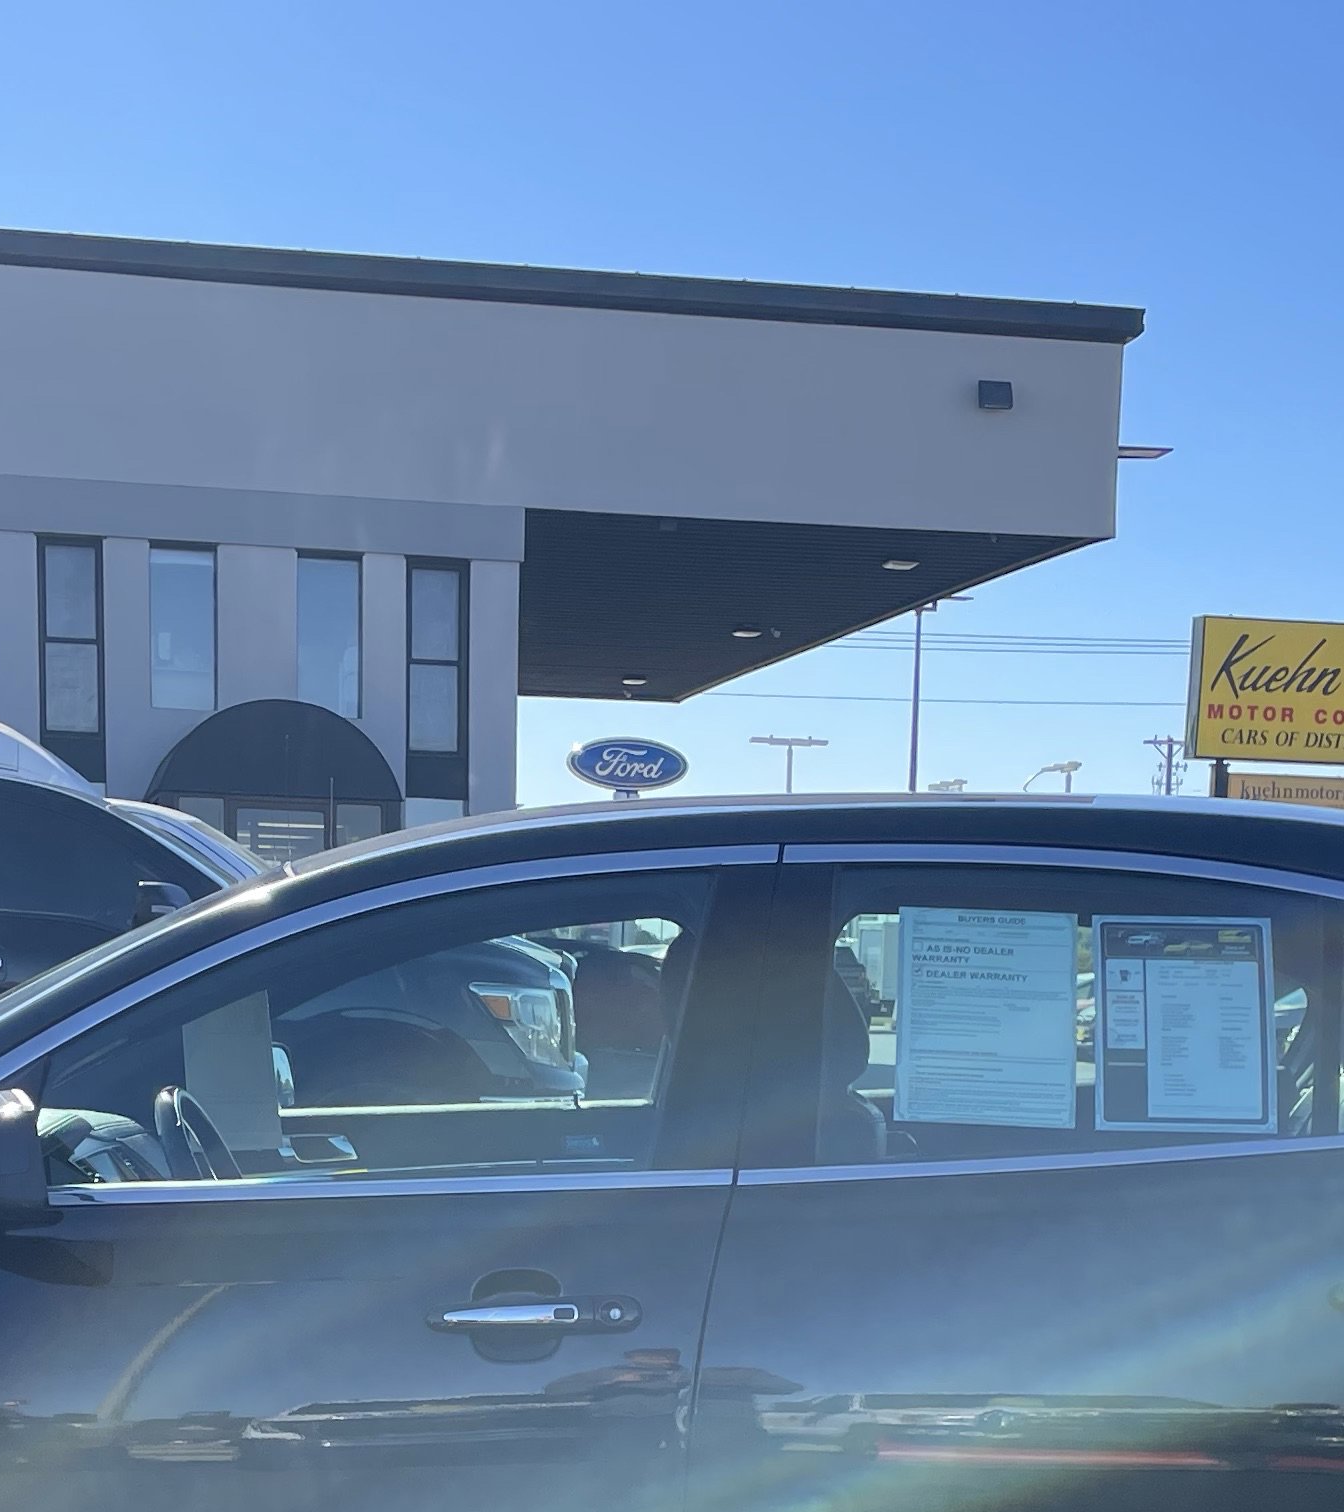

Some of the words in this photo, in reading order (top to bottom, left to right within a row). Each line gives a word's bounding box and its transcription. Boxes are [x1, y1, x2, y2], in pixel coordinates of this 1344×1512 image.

[1210, 633, 1342, 699] Kuehn
[1207, 703, 1295, 723] MOTOR
[1221, 728, 1268, 746] CARS
[1275, 729, 1300, 747] OF
[595, 747, 665, 779] Ford
[958, 915, 995, 924] BUYERS
[997, 916, 1026, 926] GUIDE
[926, 944, 941, 953] AS
[973, 946, 1015, 957] DEALER
[911, 953, 970, 965] WARRANTY
[926, 969, 967, 980] DEALER
[969, 971, 1029, 983] WARRANTY
